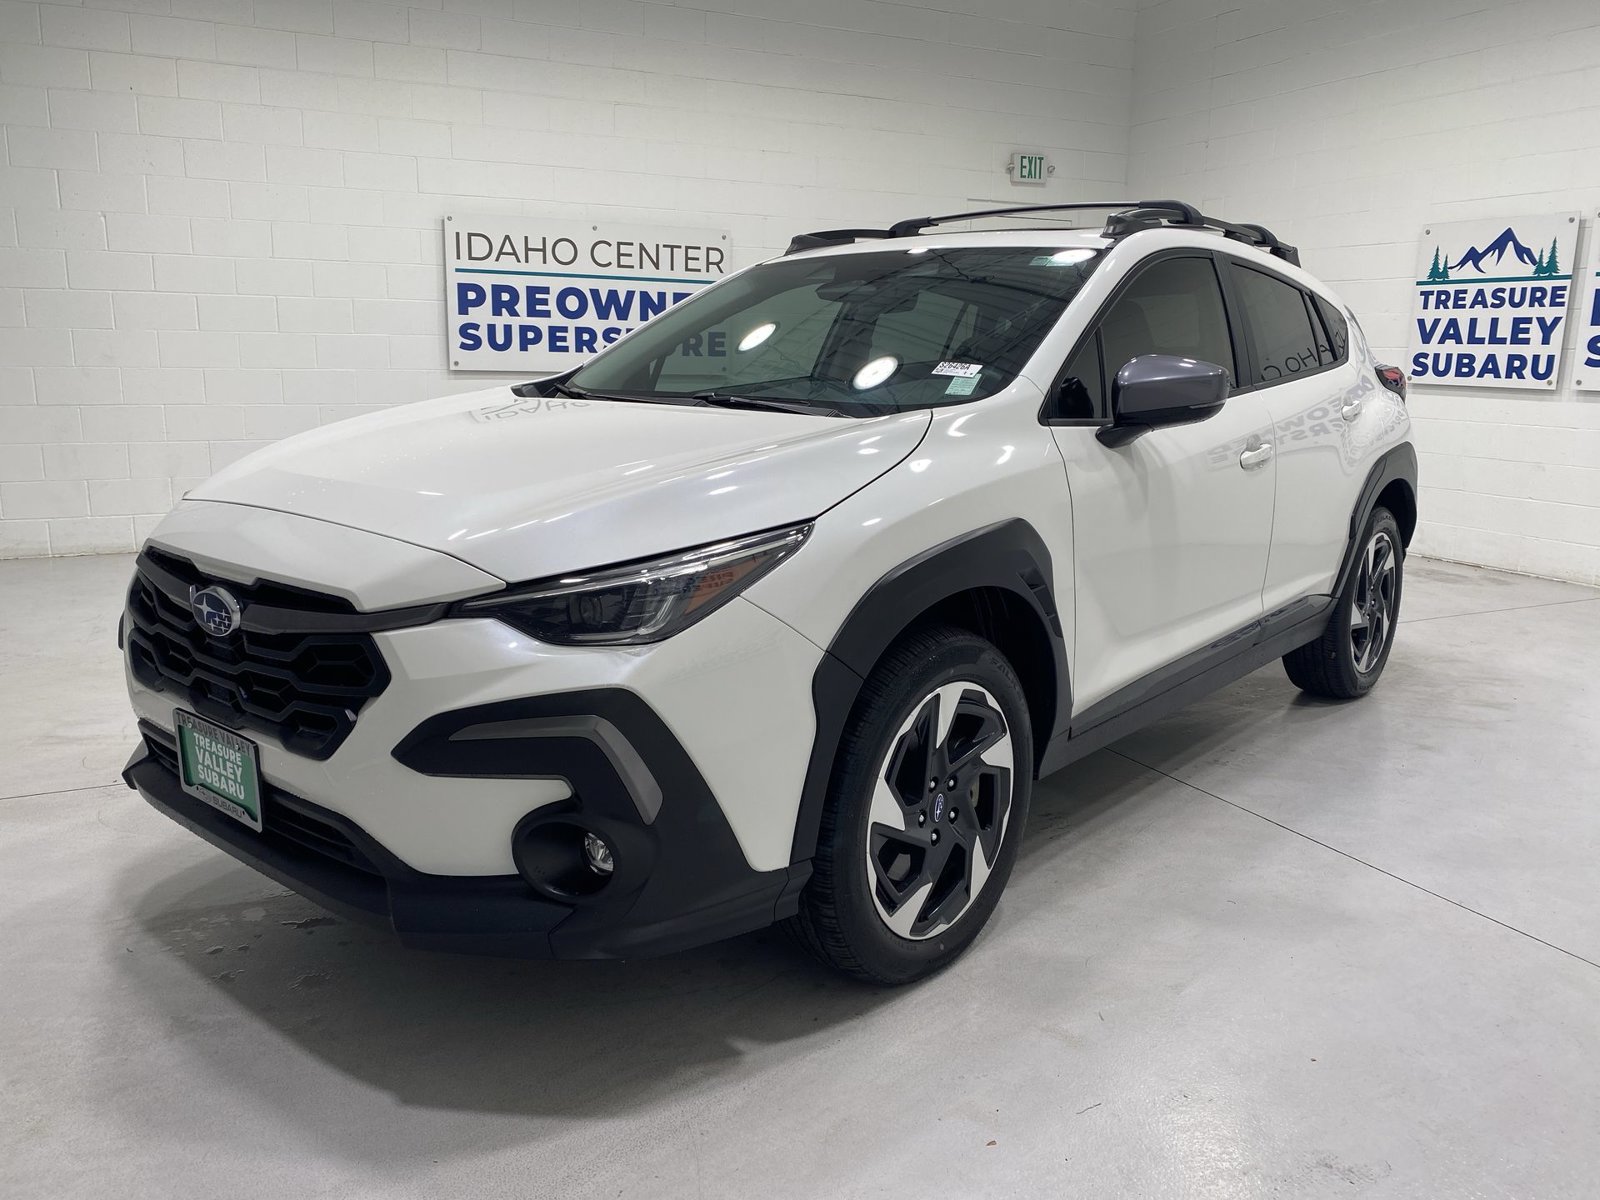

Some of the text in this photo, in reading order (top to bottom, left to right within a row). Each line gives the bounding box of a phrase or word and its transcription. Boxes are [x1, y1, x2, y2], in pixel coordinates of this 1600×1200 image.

[1020, 155, 1044, 179] EXIT
[455, 231, 725, 274] IDAHO CENTER
[457, 282, 694, 322] PREOWN
[1419, 285, 1568, 310] TREASURE
[1416, 316, 1563, 346] VALLEY
[1410, 351, 1556, 381] SUBARU
[193, 732, 242, 766] TREASURE
[195, 746, 242, 783] VALLEY
[197, 764, 245, 800] SUBARU
